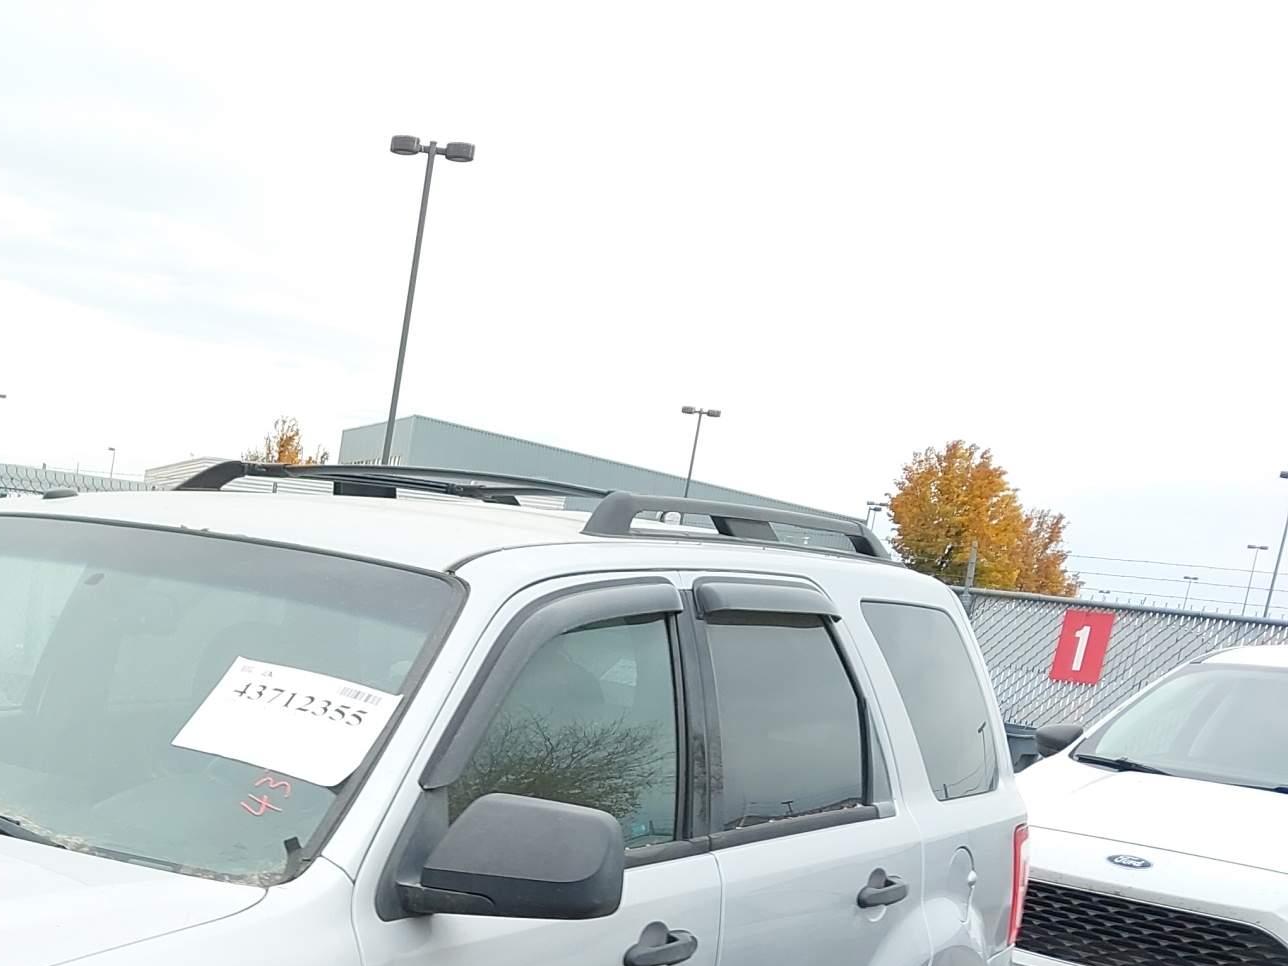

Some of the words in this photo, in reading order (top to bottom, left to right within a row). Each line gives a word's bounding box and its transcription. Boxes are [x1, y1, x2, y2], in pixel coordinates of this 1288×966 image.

[1071, 625, 1092, 672] 1
[233, 682, 369, 727] 43712355
[240, 770, 292, 817] 43
